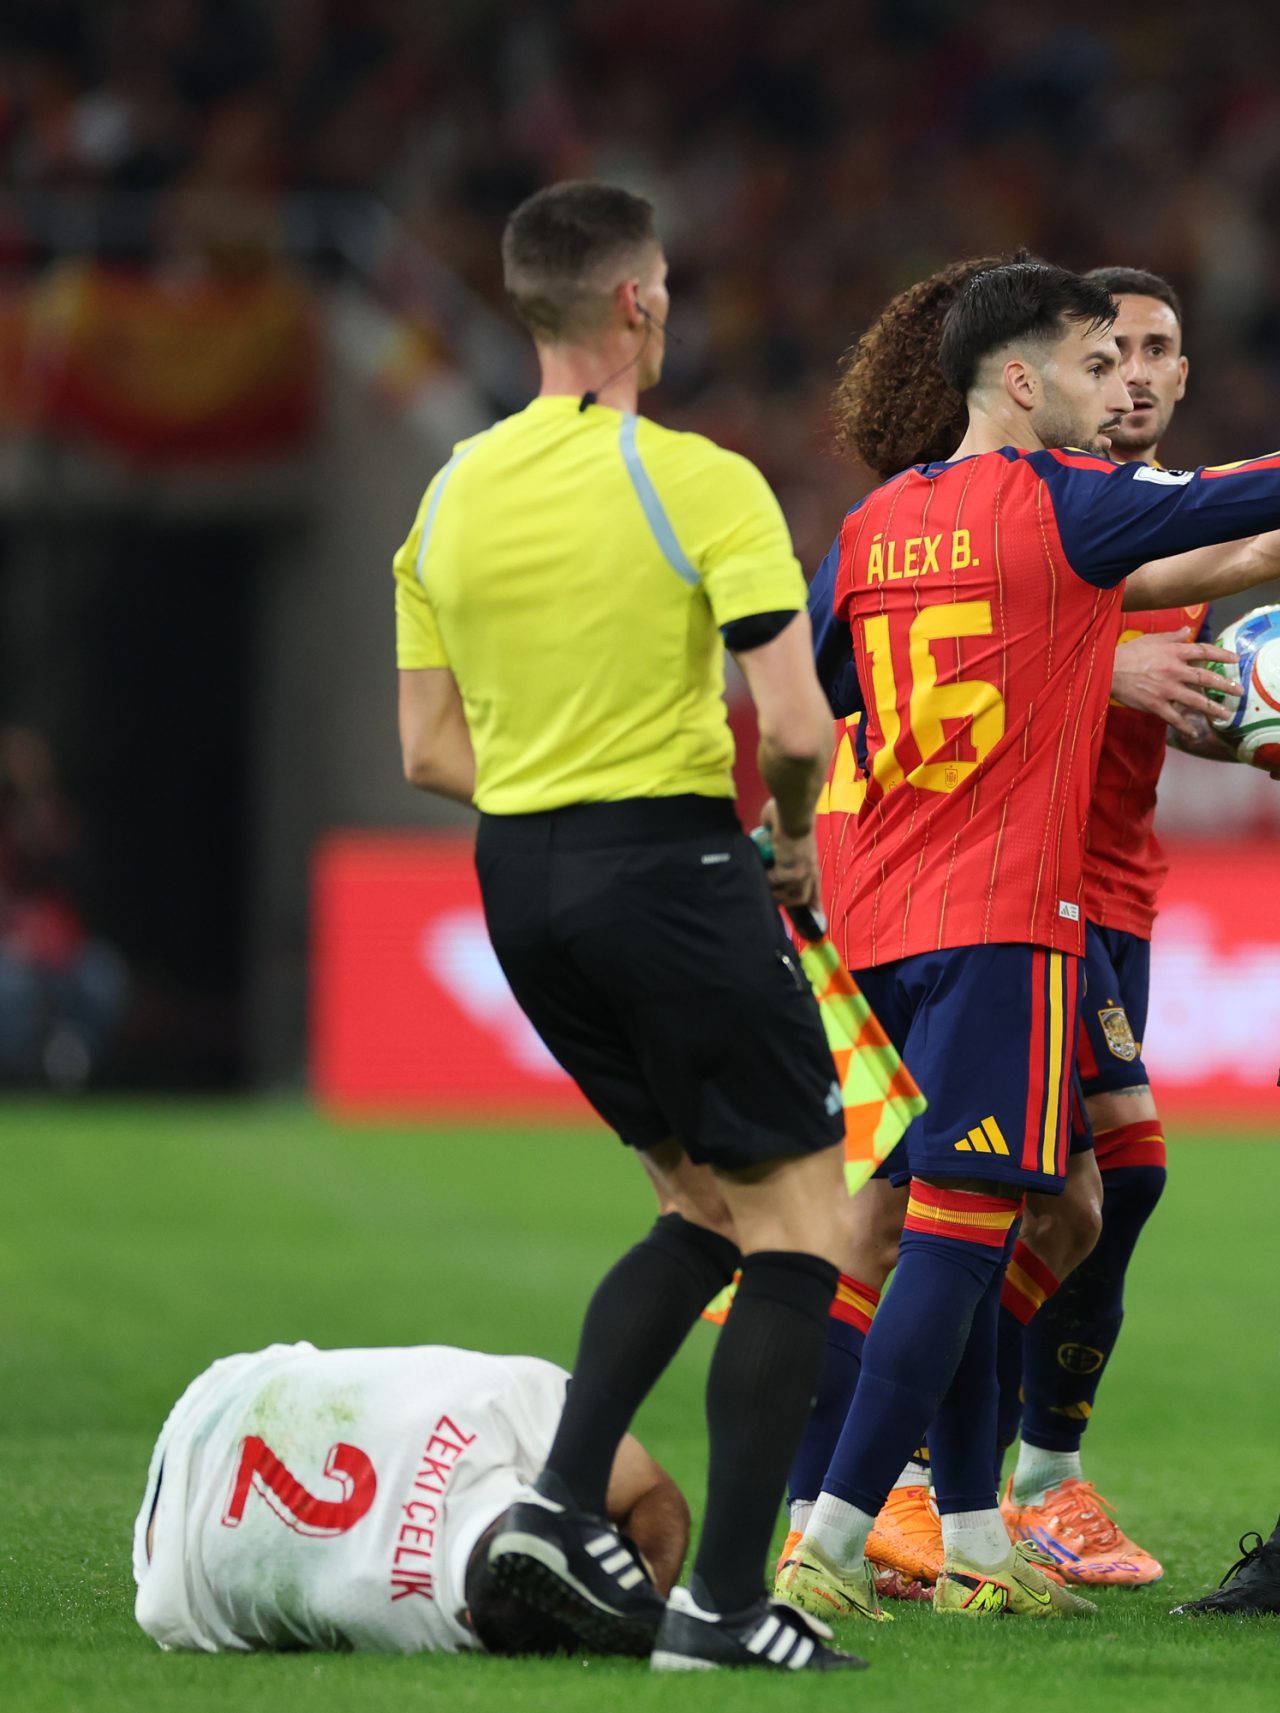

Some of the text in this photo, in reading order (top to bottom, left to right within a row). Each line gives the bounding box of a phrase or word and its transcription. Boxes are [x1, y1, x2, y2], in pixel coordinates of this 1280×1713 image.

[867, 528, 980, 585] ÁLEX B.
[863, 600, 1006, 801] 16
[221, 1434, 378, 1539] 2
